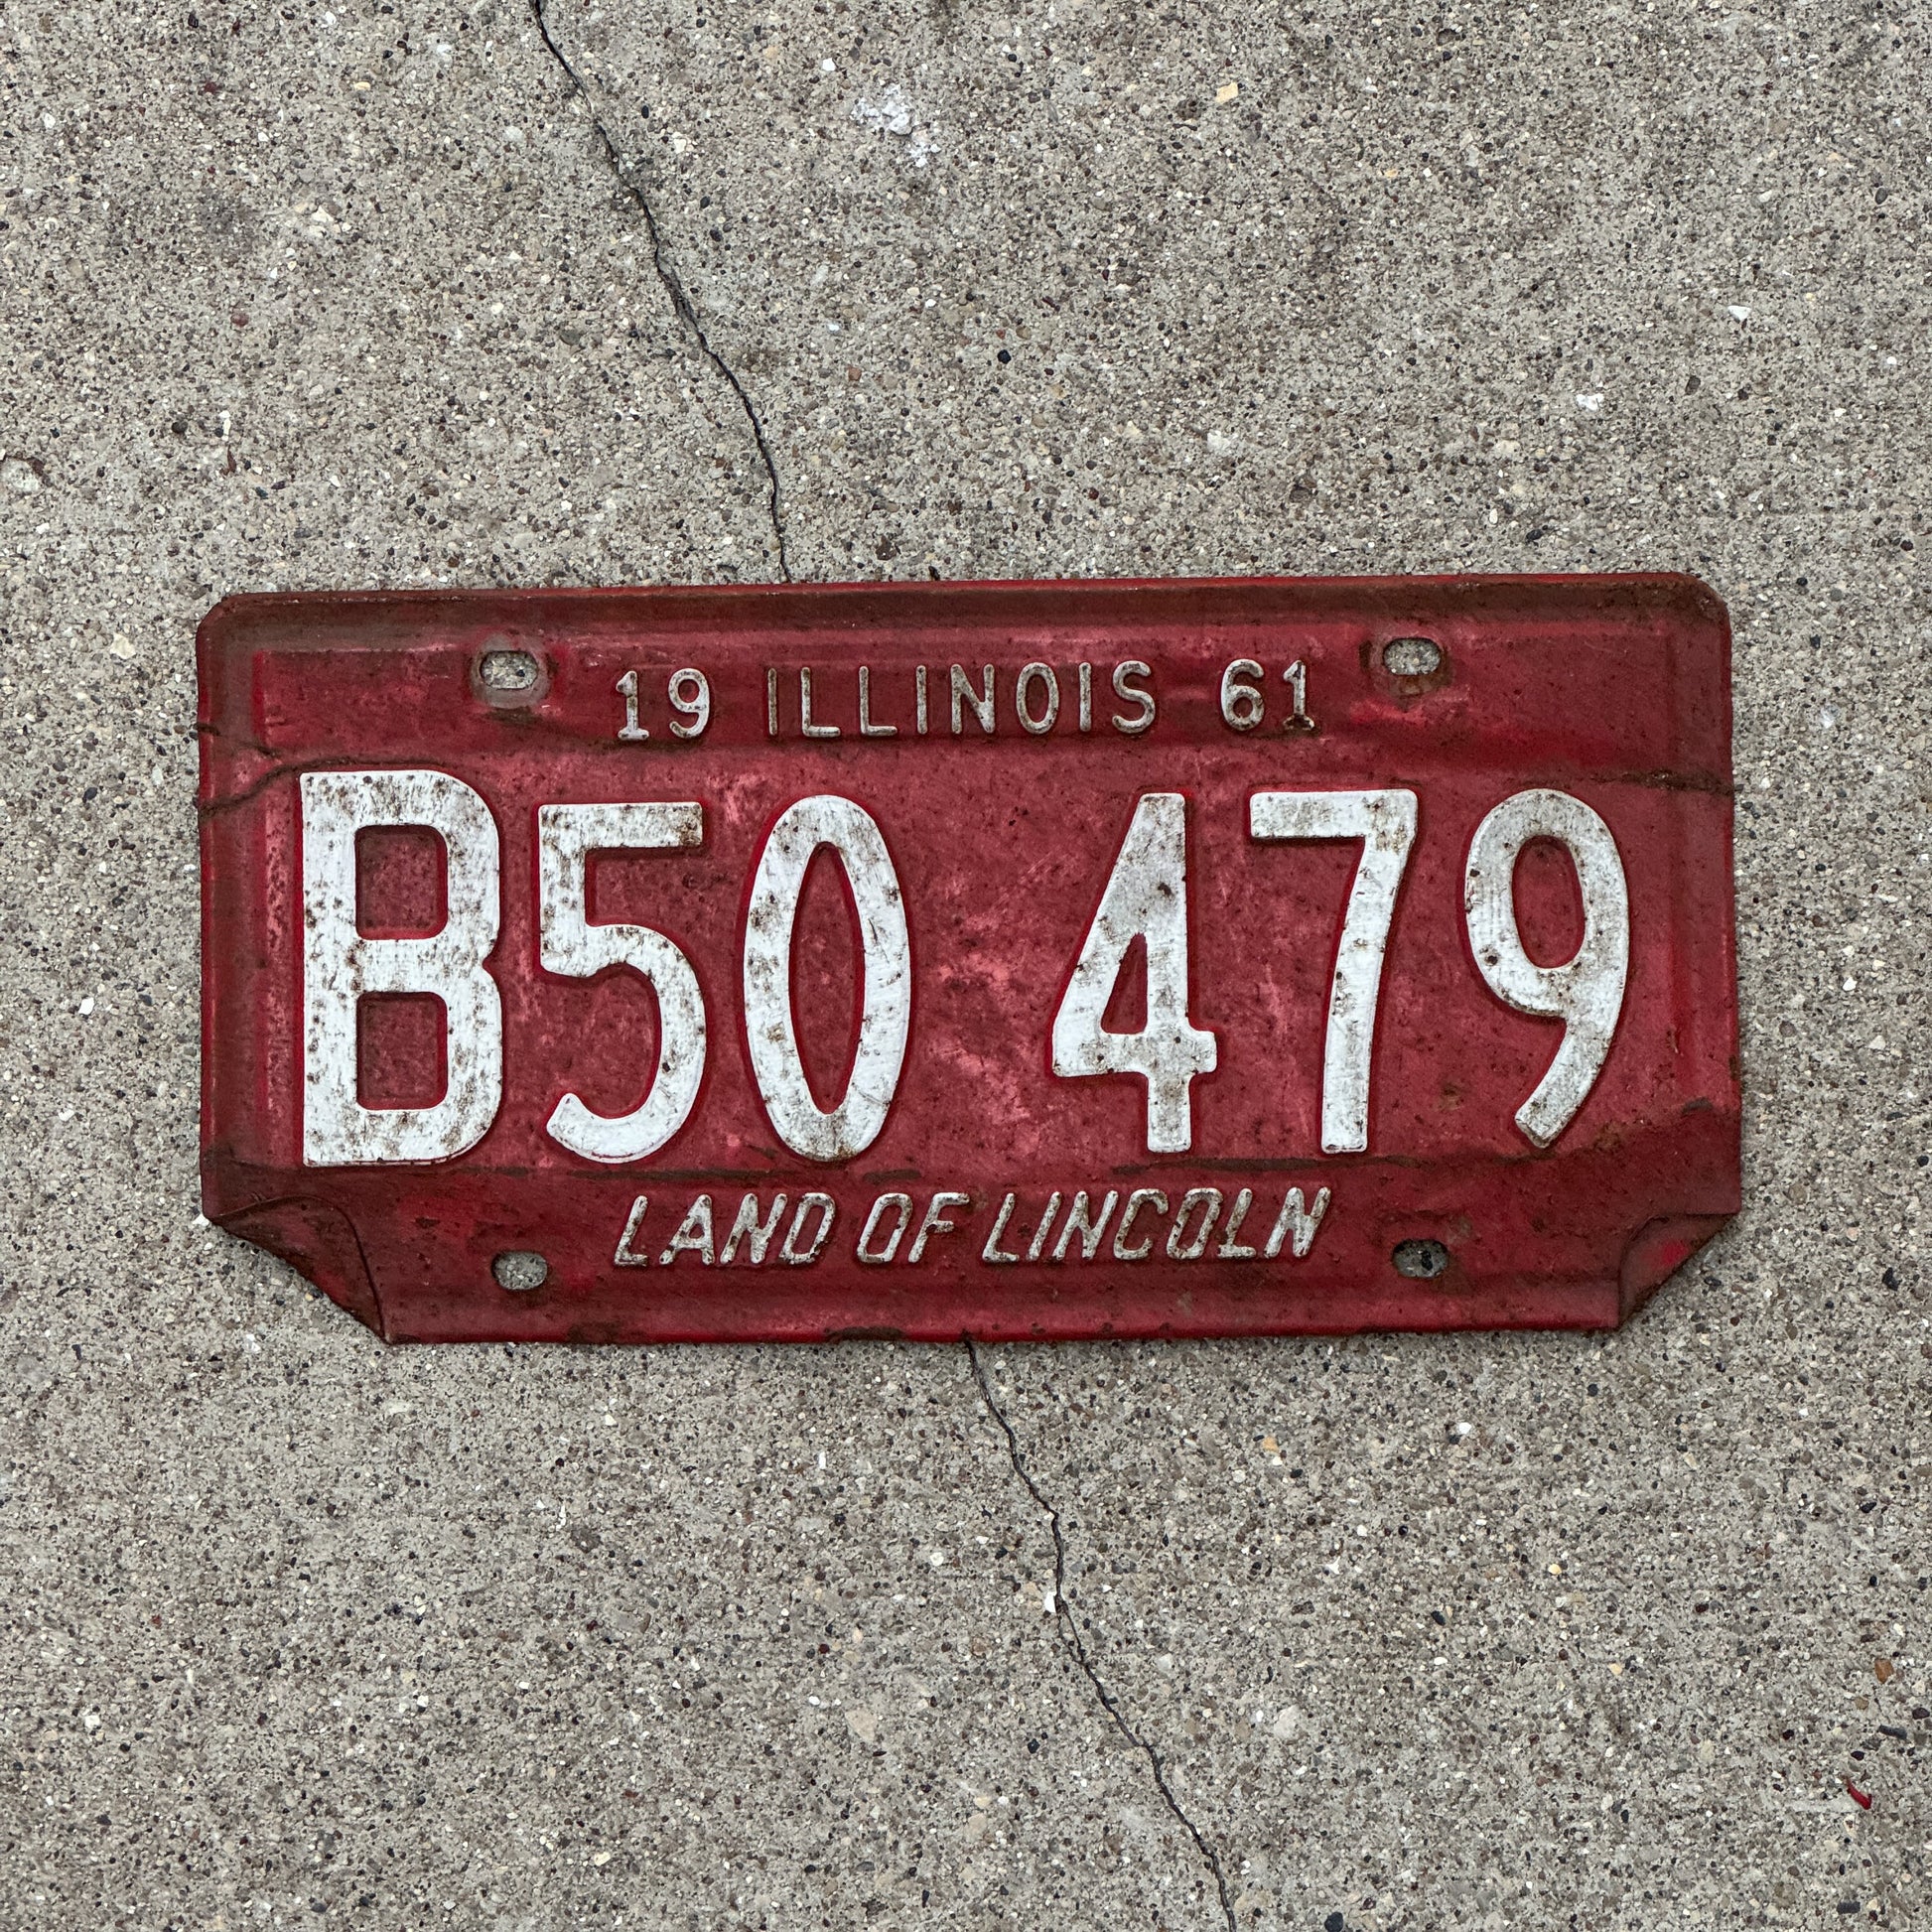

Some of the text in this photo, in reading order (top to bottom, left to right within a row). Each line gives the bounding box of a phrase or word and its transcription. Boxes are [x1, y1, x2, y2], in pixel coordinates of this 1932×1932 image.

[616, 658, 1315, 741] 19 ILLINOIS 61
[297, 768, 1630, 1168] B50 479
[614, 1186, 1331, 1266] LAND OF LINCOLN
